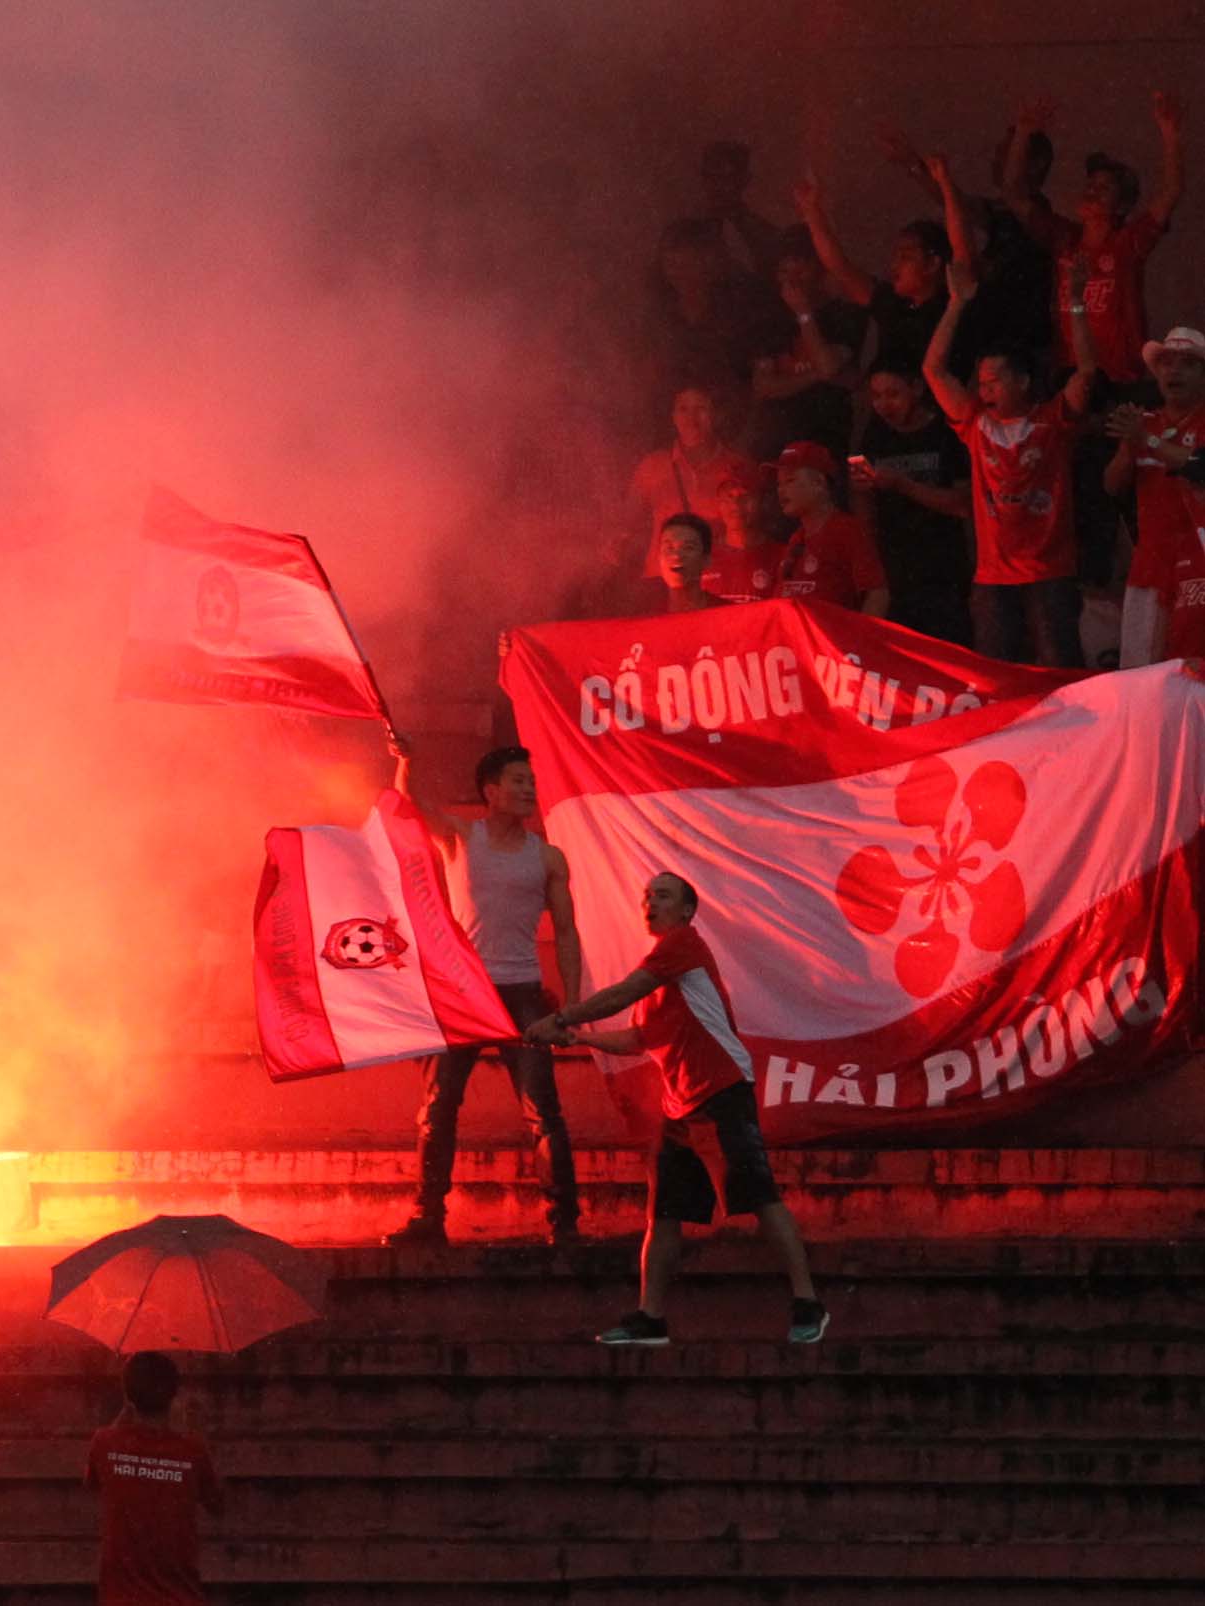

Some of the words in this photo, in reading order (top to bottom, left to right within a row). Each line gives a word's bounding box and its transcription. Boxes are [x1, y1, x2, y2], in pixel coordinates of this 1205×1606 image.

[579, 642, 646, 737] CỔ
[655, 645, 805, 745] ĐỘNG
[763, 1054, 897, 1109] HẢI
[923, 956, 1166, 1108] PHÒNG
